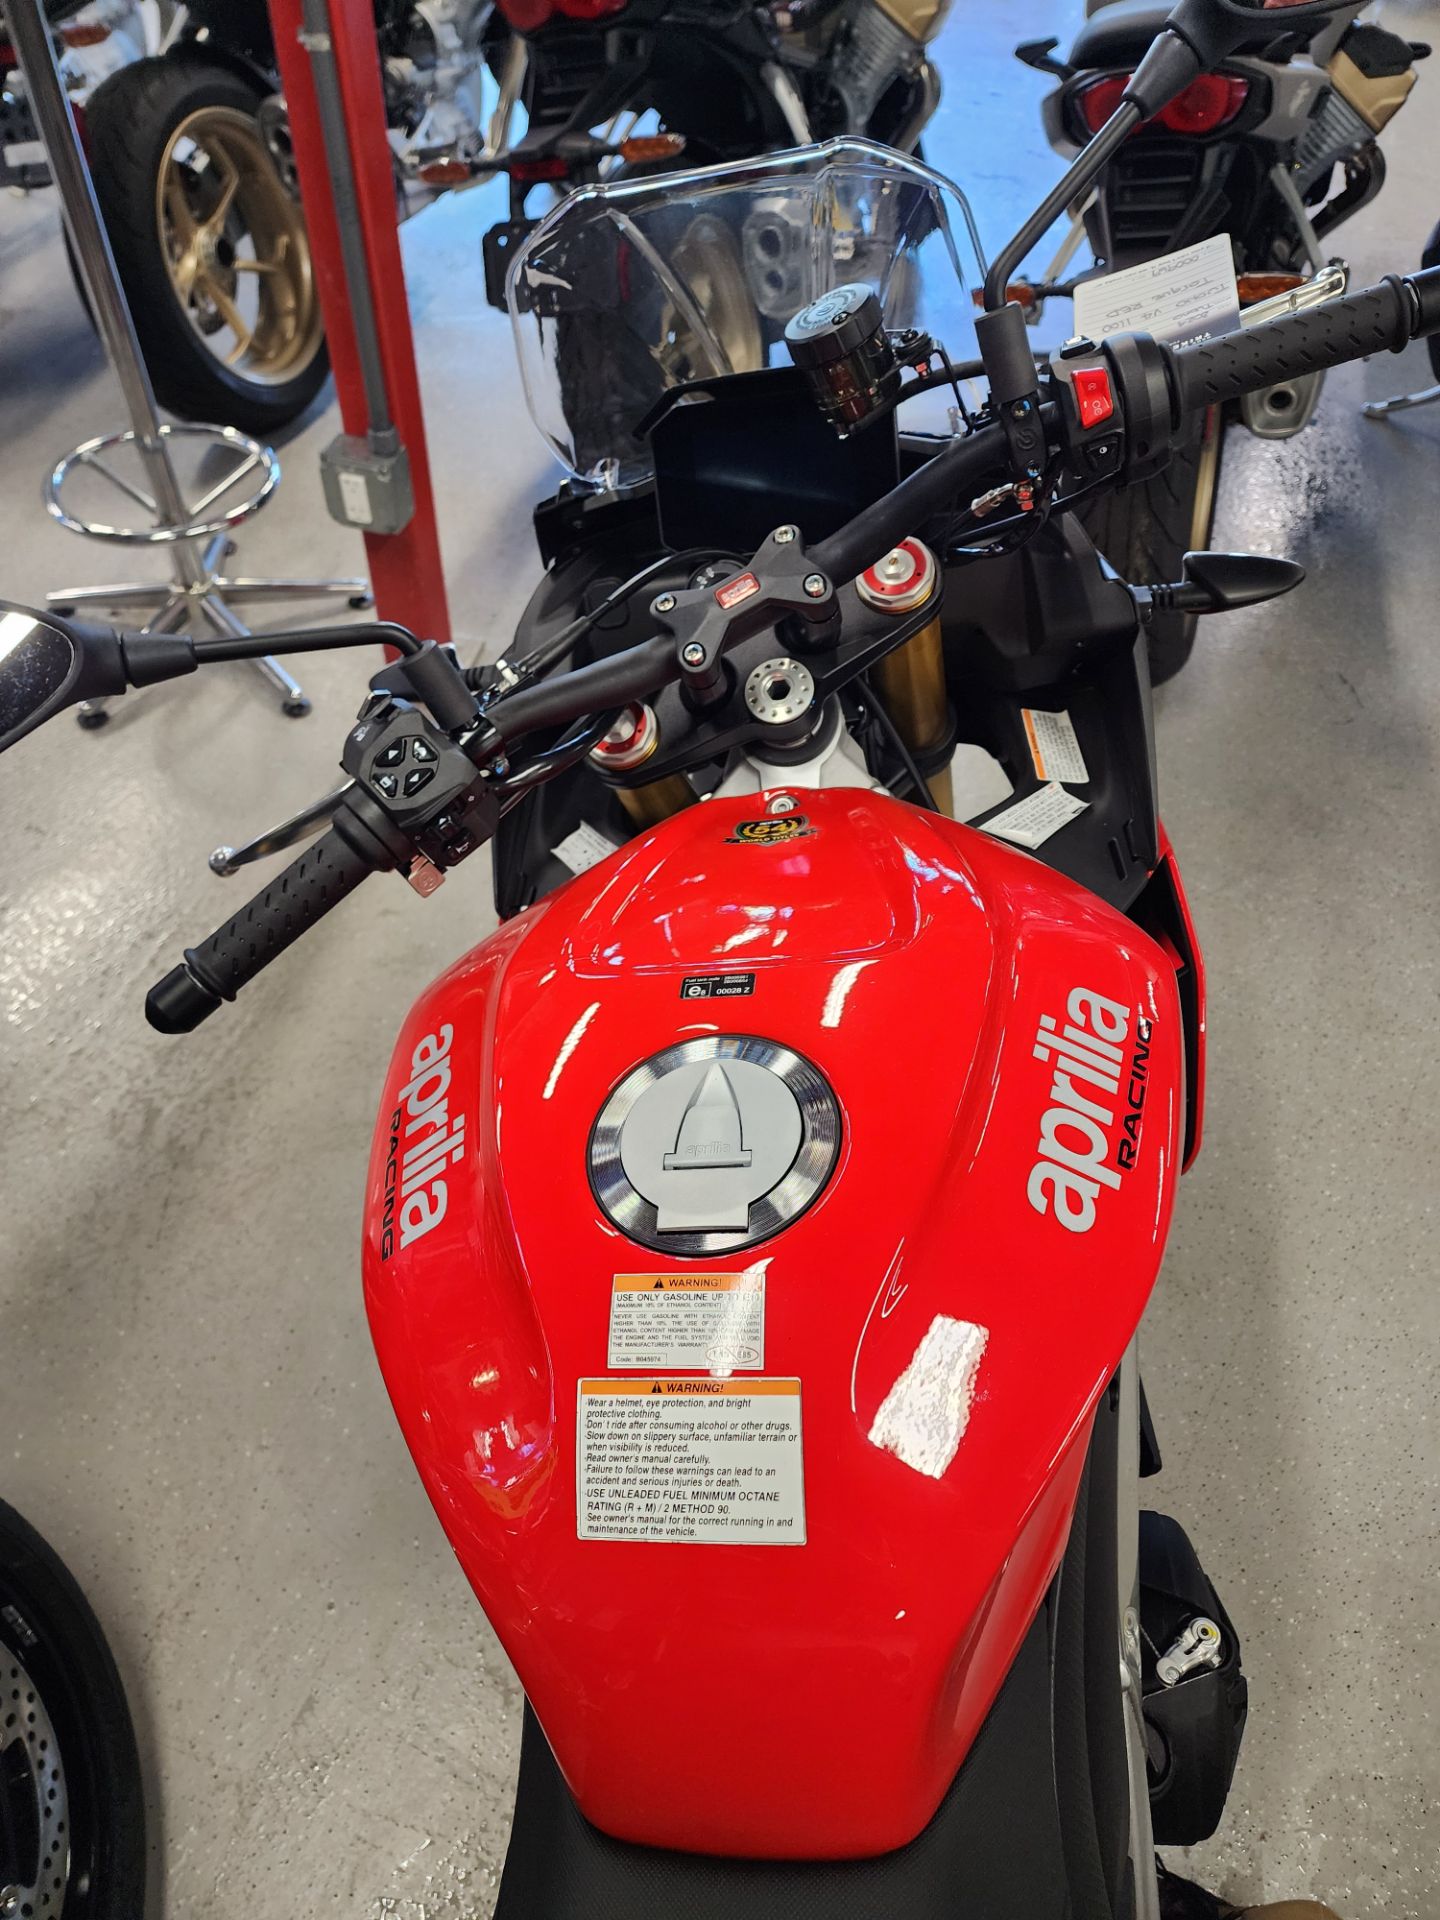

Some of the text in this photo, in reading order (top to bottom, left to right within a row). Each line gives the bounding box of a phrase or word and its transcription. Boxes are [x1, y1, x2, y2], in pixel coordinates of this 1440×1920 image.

[1106, 302, 1143, 318] RED
[1117, 1017, 1152, 1171] RACING
[1027, 987, 1130, 1233] aprilia
[398, 1023, 465, 1250] aprilia
[687, 1141, 730, 1156] aprilia
[382, 1107, 402, 1262] RACING
[669, 1279, 722, 1287] WARNING!
[616, 1294, 634, 1302] USE
[637, 1294, 660, 1302] ONLY
[664, 1293, 708, 1301] GASOLINE
[712, 1292, 724, 1300] UP
[667, 1383, 724, 1393] WARNING!
[616, 1398, 644, 1408] helmet,
[646, 1400, 660, 1410] eye
[662, 1398, 706, 1410] protection,
[708, 1399, 724, 1408] and
[726, 1398, 752, 1410] bright
[586, 1410, 662, 1420] protective clothing.
[611, 1420, 627, 1429] ride
[628, 1420, 648, 1430] after
[649, 1421, 695, 1432] consuming
[696, 1421, 728, 1430] alcohol
[730, 1422, 740, 1430] or
[740, 1421, 764, 1430] other
[765, 1421, 792, 1432] drugs.
[607, 1432, 629, 1440] down
[644, 1432, 676, 1443] slippery
[678, 1432, 712, 1443] surface,
[714, 1432, 756, 1442] unfamiliar
[758, 1432, 786, 1442] terrain
[788, 1434, 798, 1442] or
[586, 1442, 690, 1453] when visibility is reduced.
[608, 1454, 640, 1463] owner's
[642, 1454, 672, 1464] manual
[673, 1454, 710, 1466] carefully.
[614, 1466, 623, 1474] to
[625, 1465, 649, 1474] follow
[651, 1466, 674, 1474] these
[676, 1466, 714, 1478] warnings
[734, 1467, 752, 1476] lead
[754, 1468, 763, 1476] to
[586, 1476, 620, 1485] accident
[622, 1476, 638, 1485] and
[638, 1477, 669, 1486] serious
[671, 1476, 702, 1488] injuries
[716, 1478, 742, 1488] death.
[608, 1489, 660, 1500] UNLEADED
[662, 1490, 688, 1500] FUEL
[691, 1491, 736, 1500] MINIMUM
[738, 1492, 780, 1502] OCTANE
[587, 1502, 622, 1511] RATING
[624, 1502, 634, 1513] (R
[644, 1503, 656, 1514] M)
[664, 1504, 670, 1512] 2
[672, 1504, 715, 1514] METHOD
[717, 1504, 731, 1514] 90.
[604, 1515, 634, 1524] owner's
[637, 1514, 666, 1524] manual
[668, 1515, 680, 1524] for
[682, 1516, 696, 1525] the
[698, 1516, 728, 1526] correct
[730, 1517, 764, 1528] running
[766, 1516, 774, 1526] in
[776, 1517, 794, 1526] and
[588, 1525, 697, 1536] maintenance of the vehicle.
